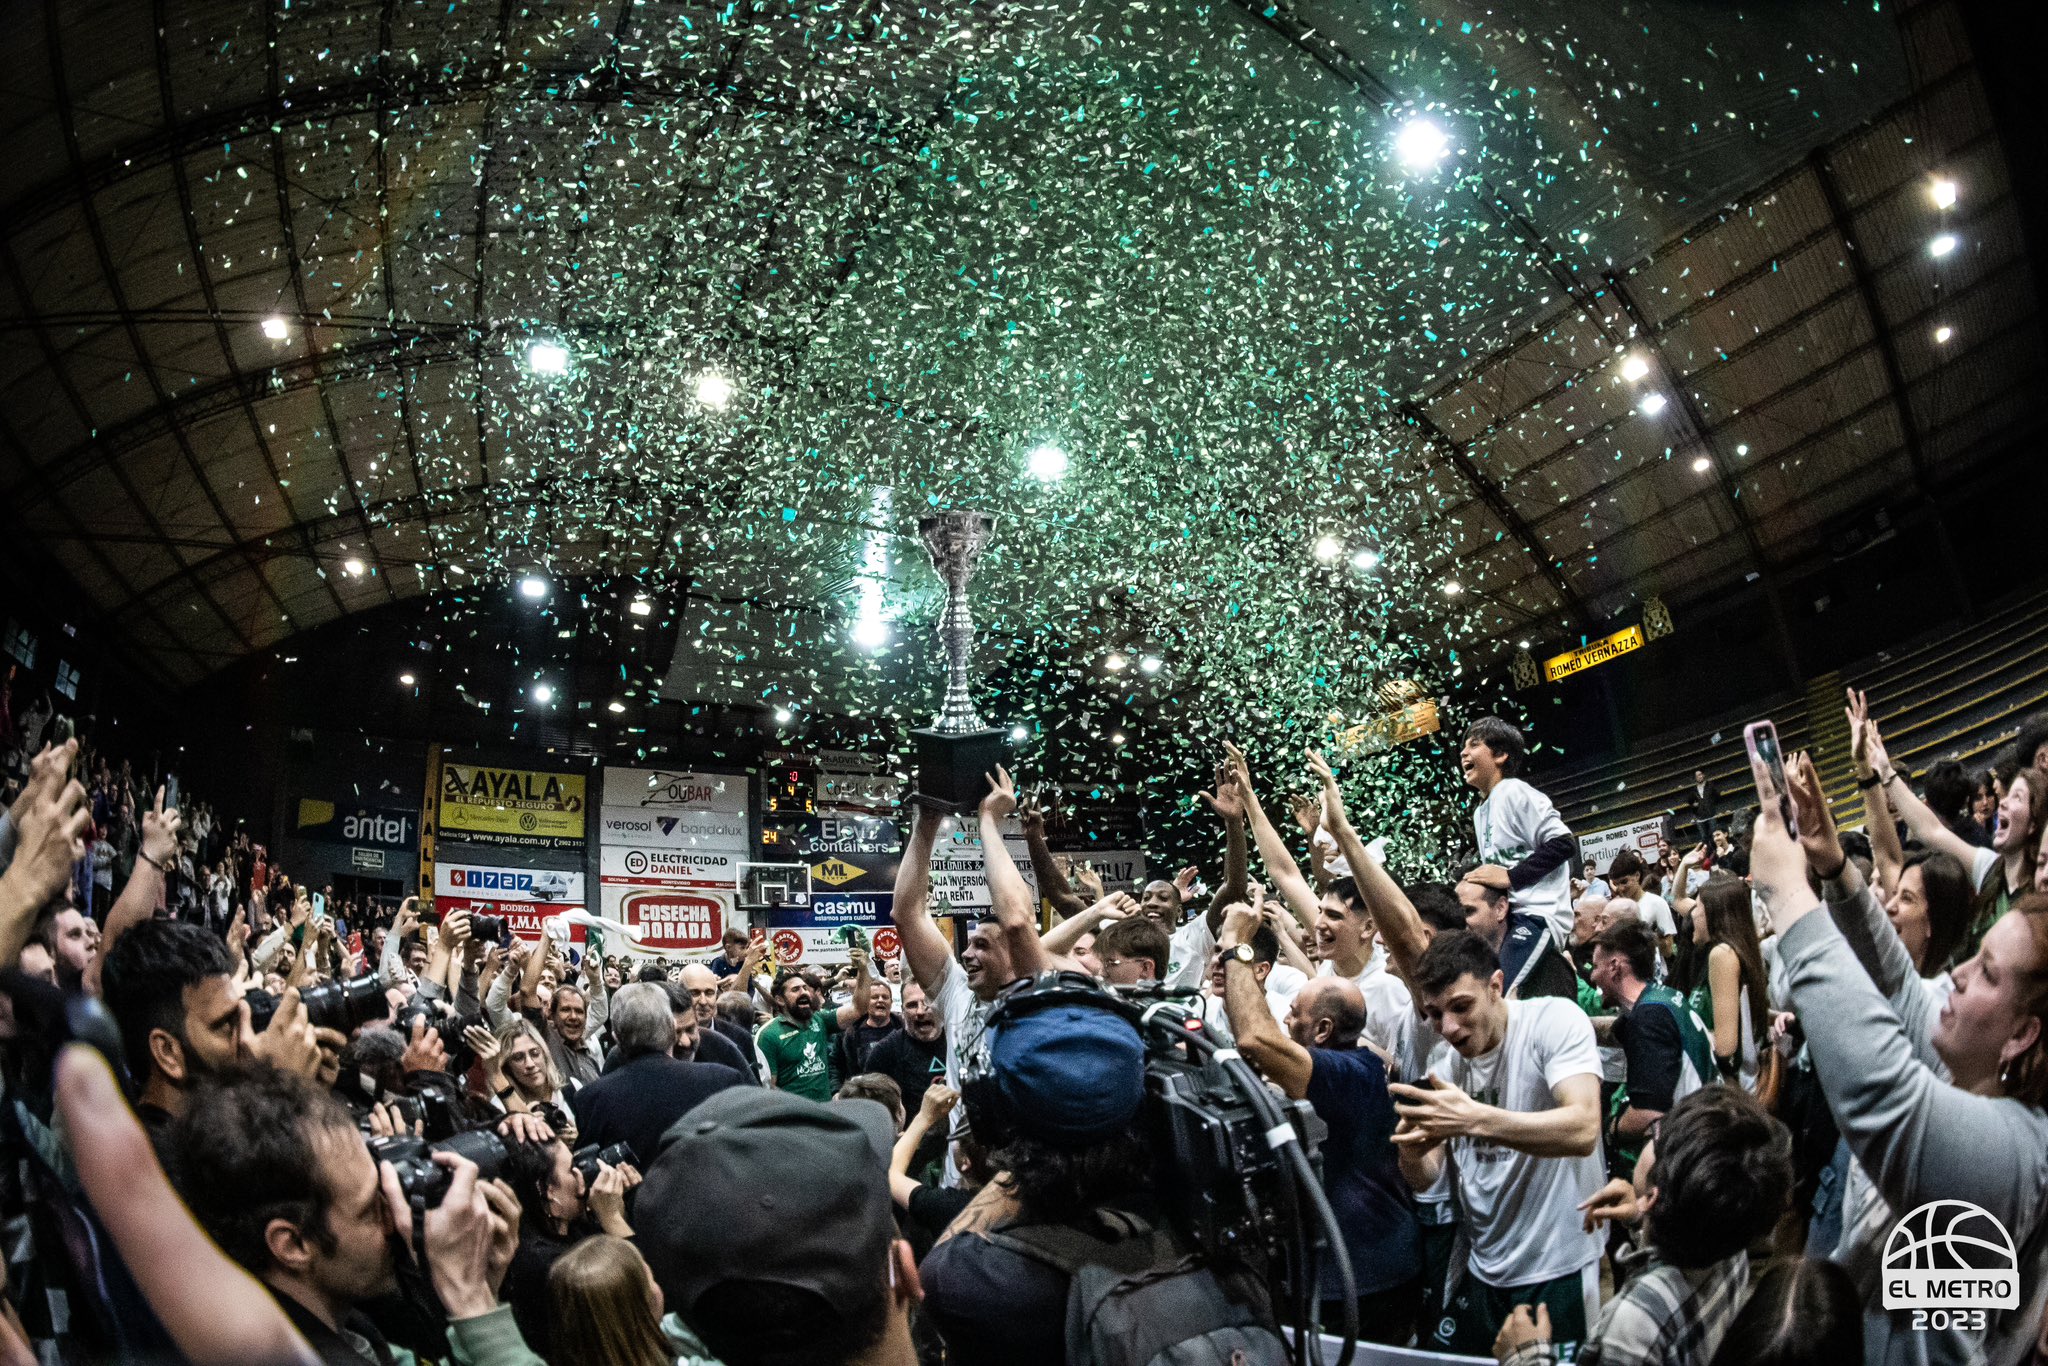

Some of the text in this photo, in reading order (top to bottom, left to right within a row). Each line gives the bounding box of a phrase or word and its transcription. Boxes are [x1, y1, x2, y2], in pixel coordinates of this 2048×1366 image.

[1551, 635, 1639, 678] ROMEO VERNAZZA
[470, 770, 562, 802] AYALA
[456, 795, 555, 811] EL REPUESTO SEGURO
[343, 813, 406, 844] antel
[606, 820, 652, 832] verosol
[681, 822, 743, 836] bandalux
[472, 833, 551, 847] www.ayala.com.uy
[763, 830, 777, 844] 24
[1582, 821, 1660, 846] Estadio ROMEO SCHINCA
[810, 841, 889, 853] containers
[630, 858, 643, 867] ED
[651, 853, 728, 866] ELECTRICIDAD
[651, 864, 692, 875] DANIEL
[821, 863, 848, 876] ML
[472, 874, 532, 889] 1727
[950, 890, 974, 901] RENTA
[500, 903, 536, 913] BODEGA
[639, 904, 711, 922] COSECHA
[814, 901, 876, 915] casmu
[839, 915, 853, 923] para
[641, 921, 712, 939] DORADA
[812, 938, 829, 946] Tel.:
